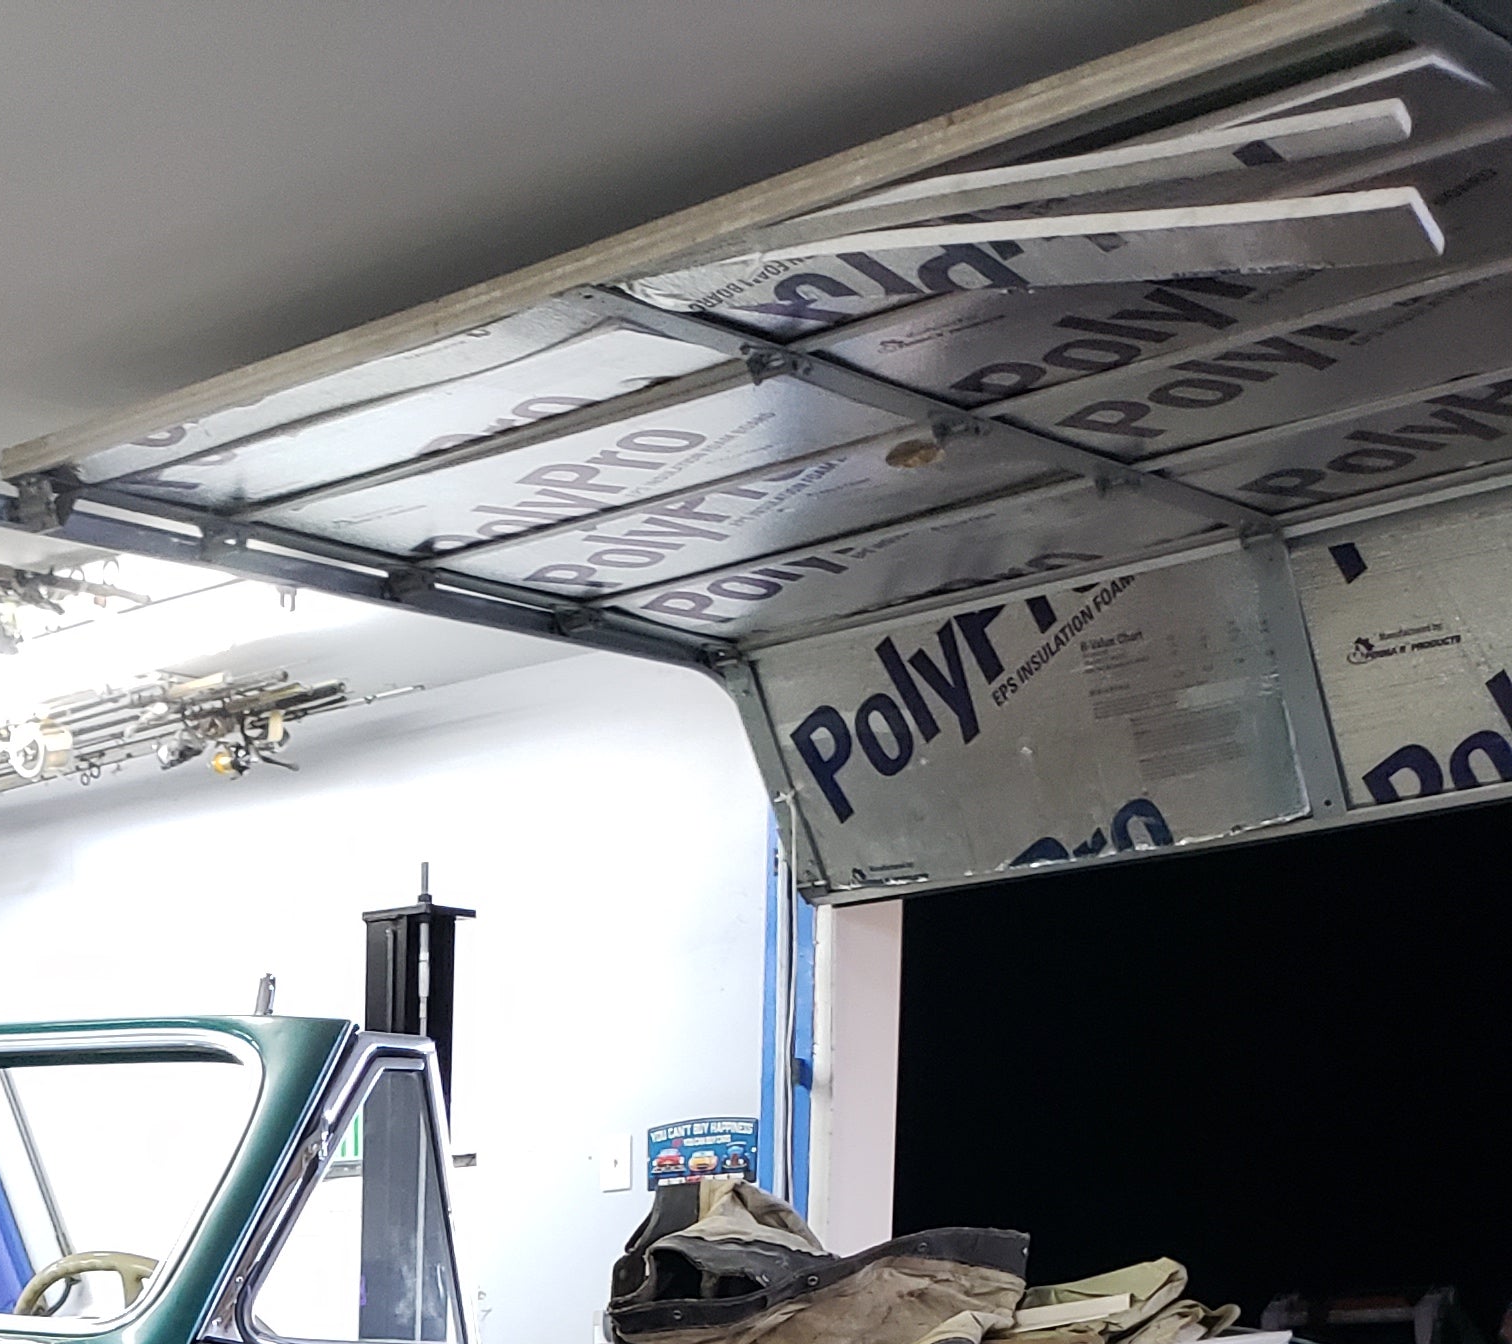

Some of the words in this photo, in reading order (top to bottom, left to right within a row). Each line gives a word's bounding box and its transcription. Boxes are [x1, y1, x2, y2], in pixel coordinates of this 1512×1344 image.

[992, 675, 1019, 707] EPS
[1016, 604, 1095, 684] INSULATION
[1092, 574, 1136, 613] FOAM
[667, 1123, 693, 1139] CAN'T
